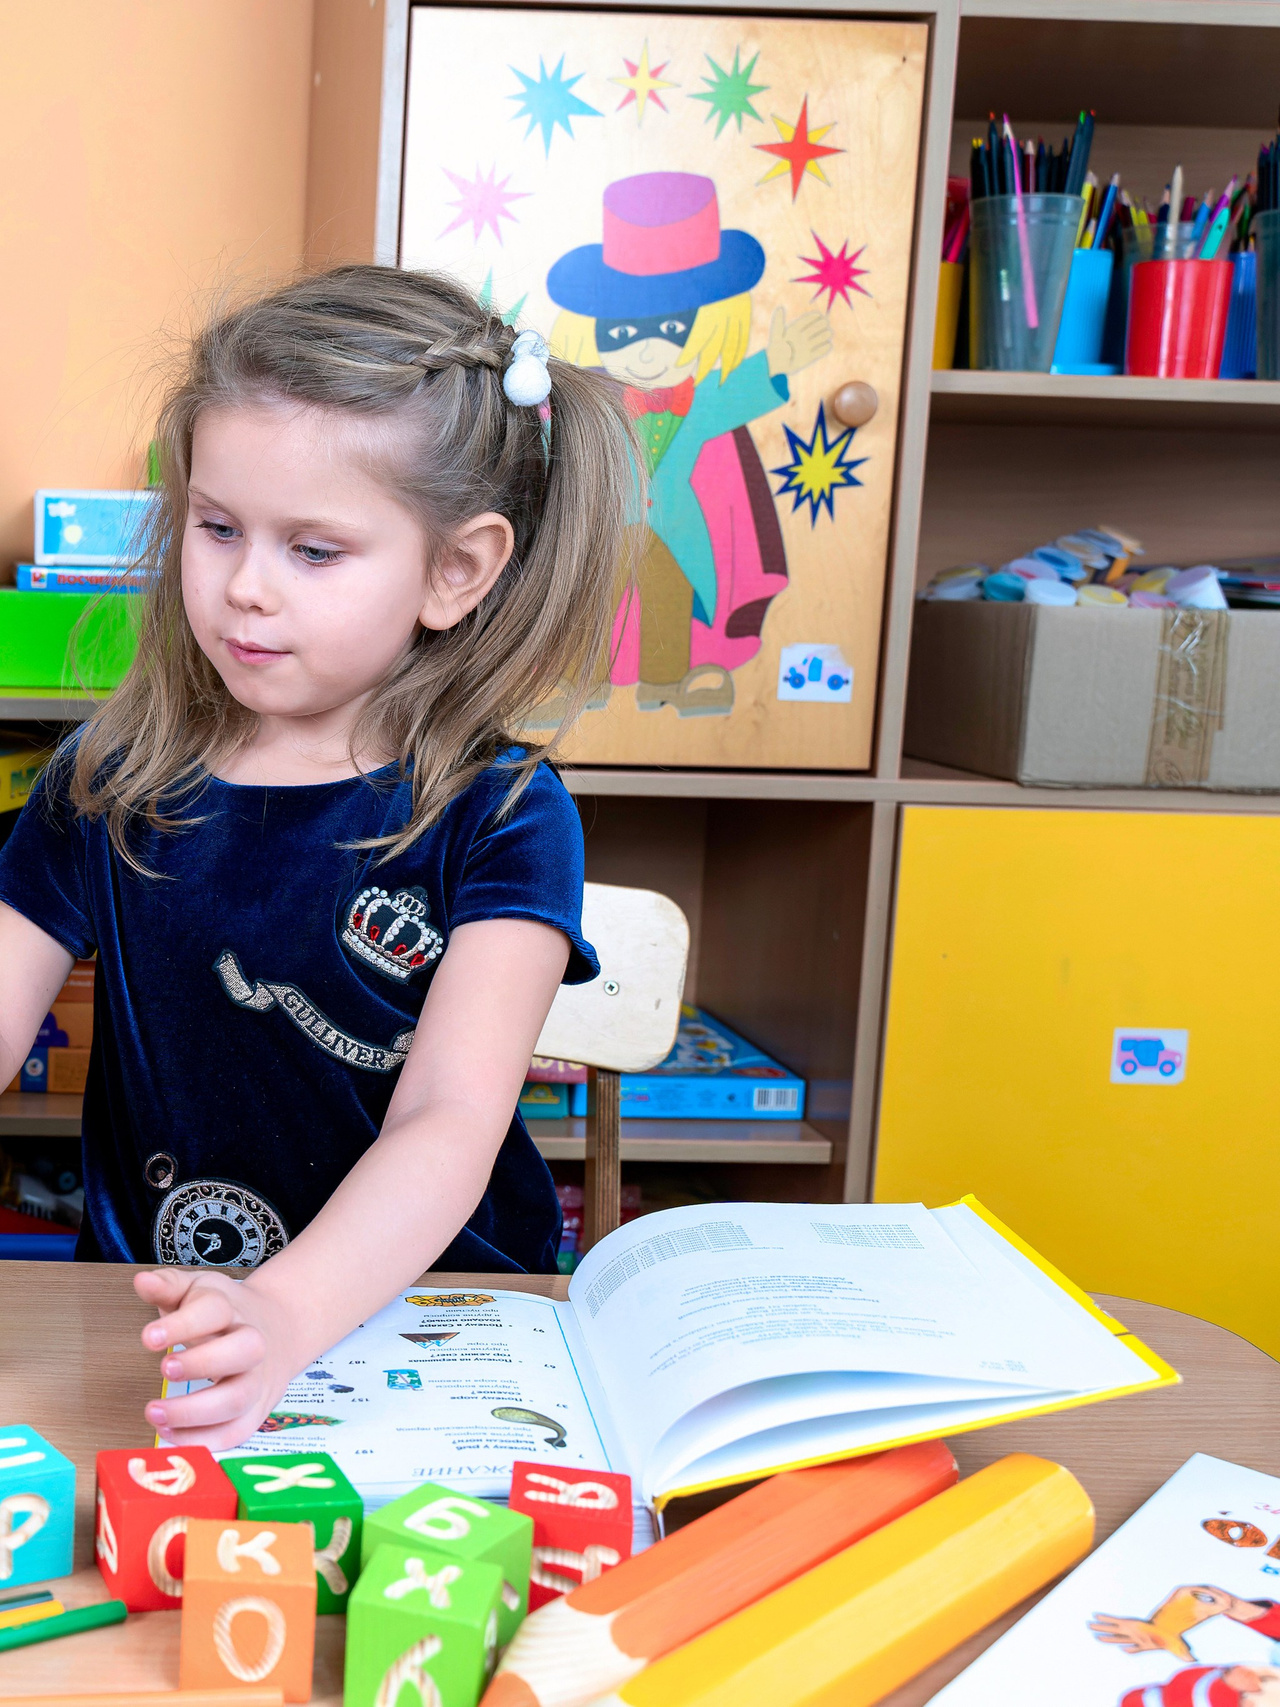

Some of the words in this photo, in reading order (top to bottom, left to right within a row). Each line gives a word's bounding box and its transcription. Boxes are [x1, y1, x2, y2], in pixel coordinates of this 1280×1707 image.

[284, 991, 386, 1068] GULLIVER
[243, 1463, 336, 1494] Х
[213, 1594, 287, 1683] О
